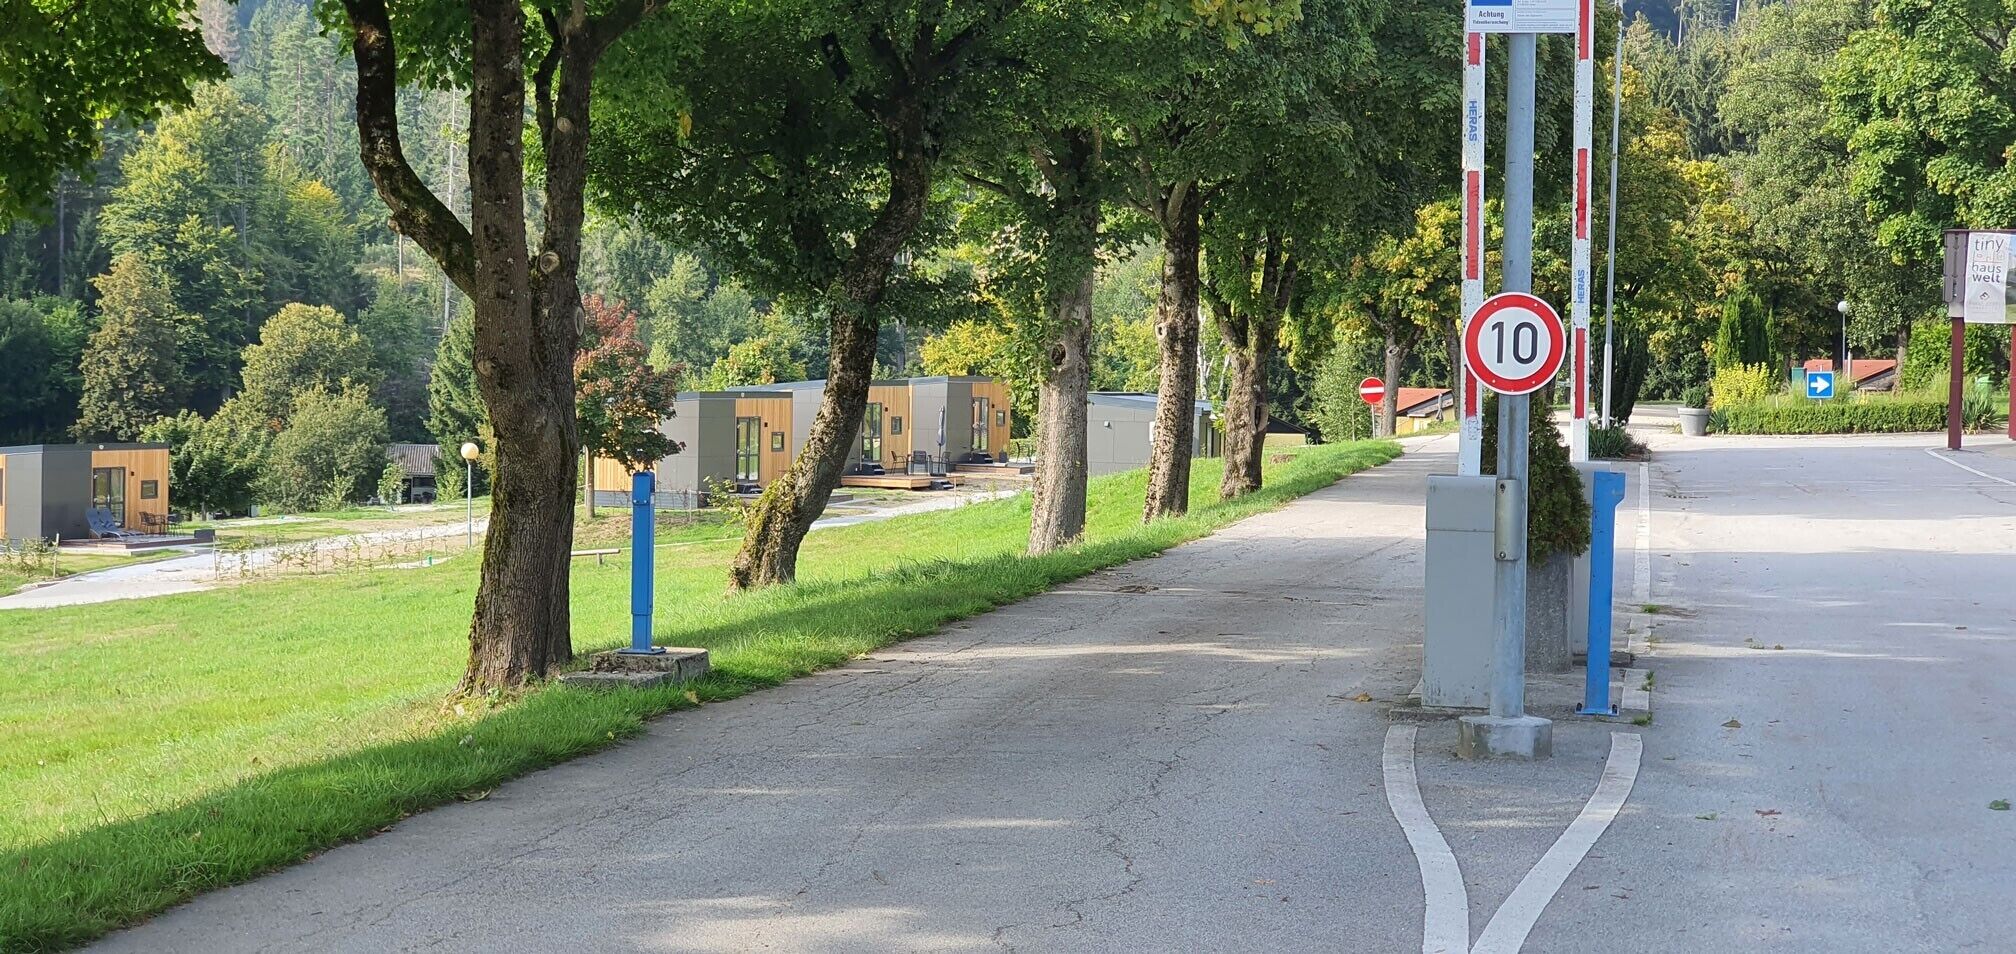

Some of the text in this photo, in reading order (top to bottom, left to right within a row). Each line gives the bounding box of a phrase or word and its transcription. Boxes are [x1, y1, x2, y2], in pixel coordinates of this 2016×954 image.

[1478, 10, 1505, 19] Achtung
[1468, 100, 1478, 142] HERAS
[1975, 237, 2004, 252] tiny
[1972, 262, 2002, 273] haus
[1972, 273, 2001, 283] welt
[1576, 269, 1586, 304] HERAS
[1491, 320, 1540, 366] 10
